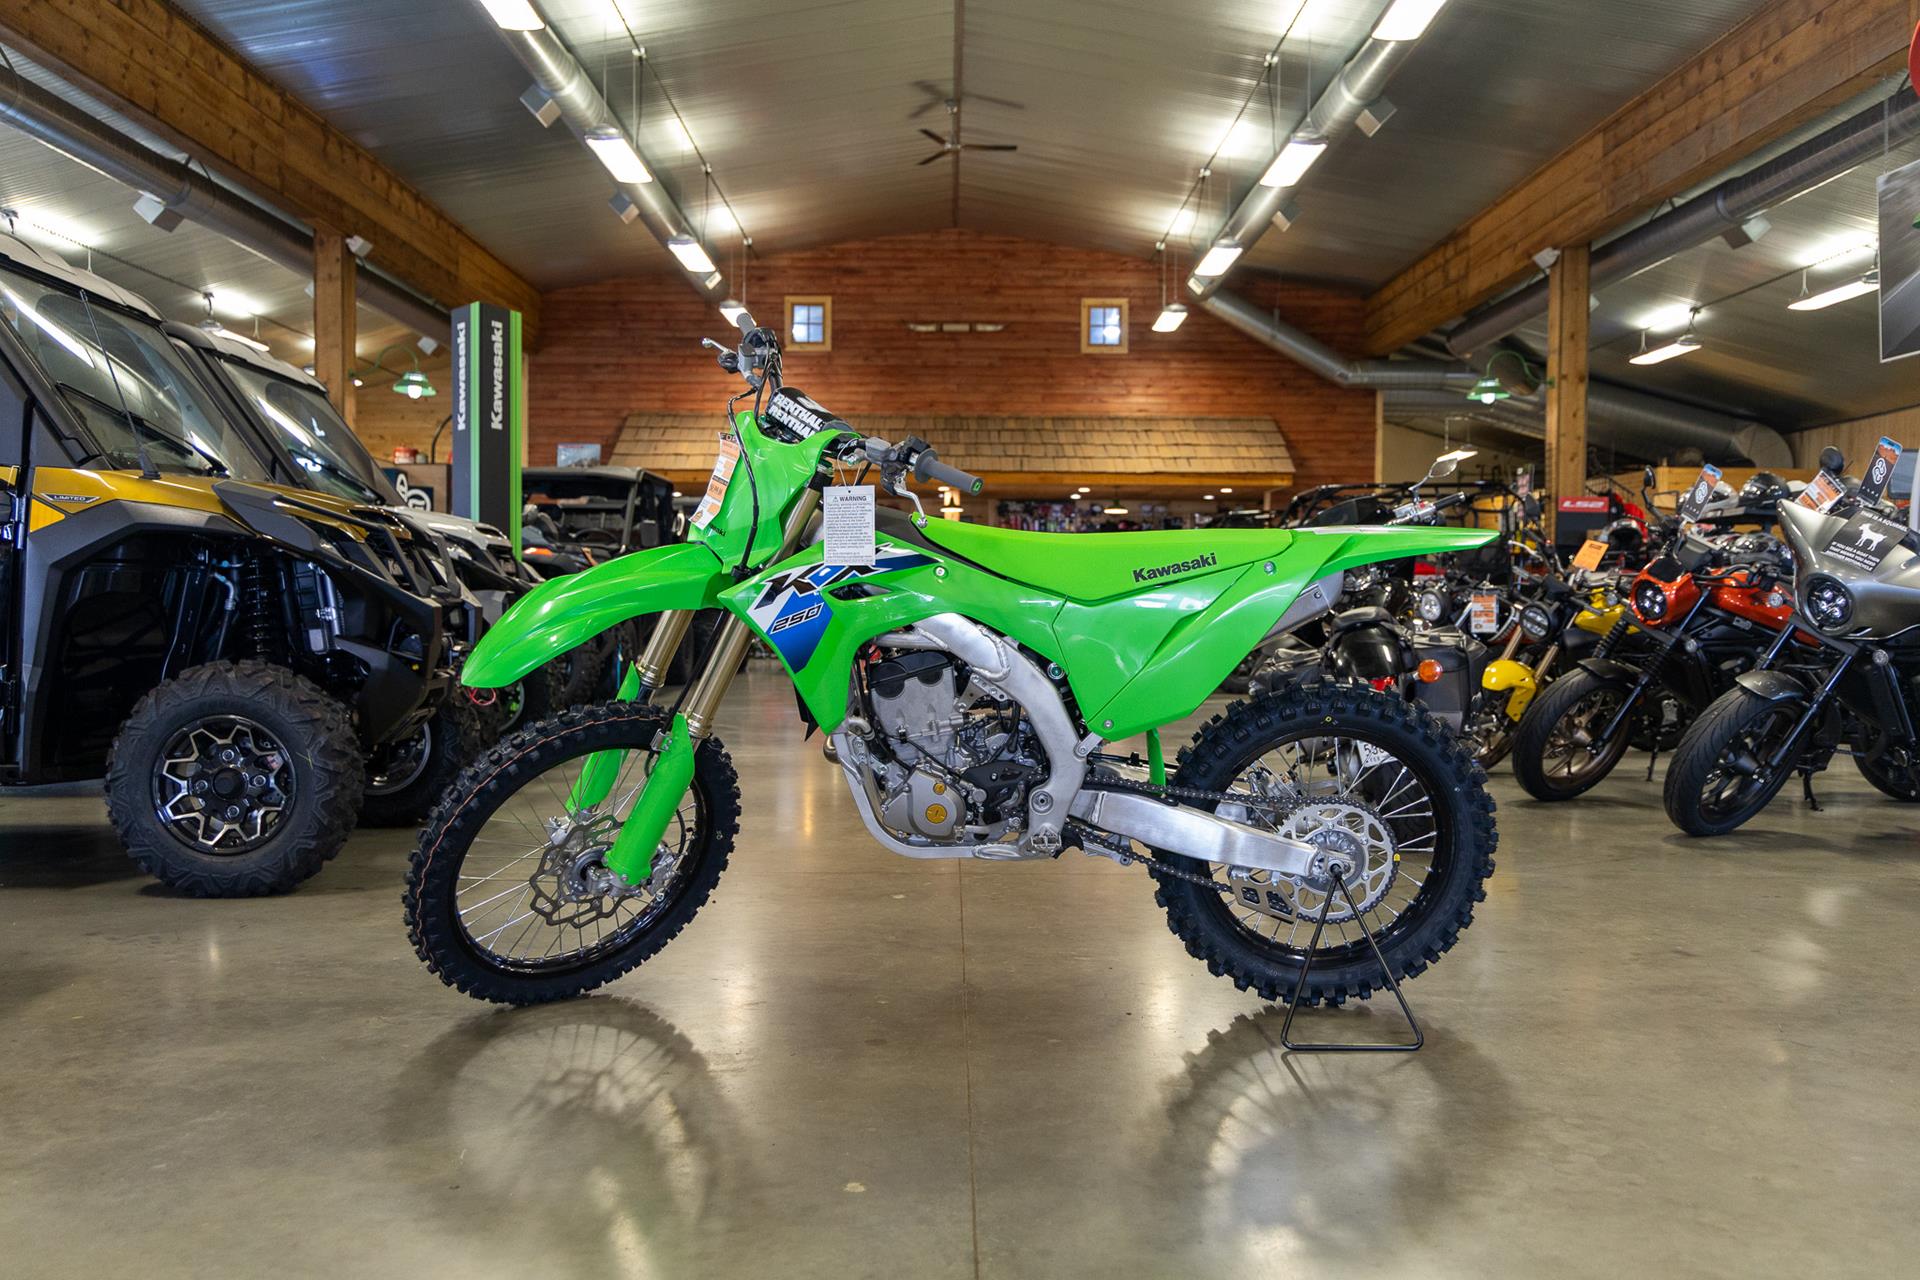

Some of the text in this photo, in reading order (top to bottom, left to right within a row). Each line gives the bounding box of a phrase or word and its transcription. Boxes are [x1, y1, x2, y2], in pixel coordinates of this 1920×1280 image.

[457, 321, 466, 431] Kawasaki
[491, 320, 503, 430] Kawasaki
[772, 392, 825, 431] RENTHAL
[1882, 518, 1908, 532] SQUIRREL
[1132, 552, 1217, 583] Kawasaki
[771, 603, 824, 634] 250
